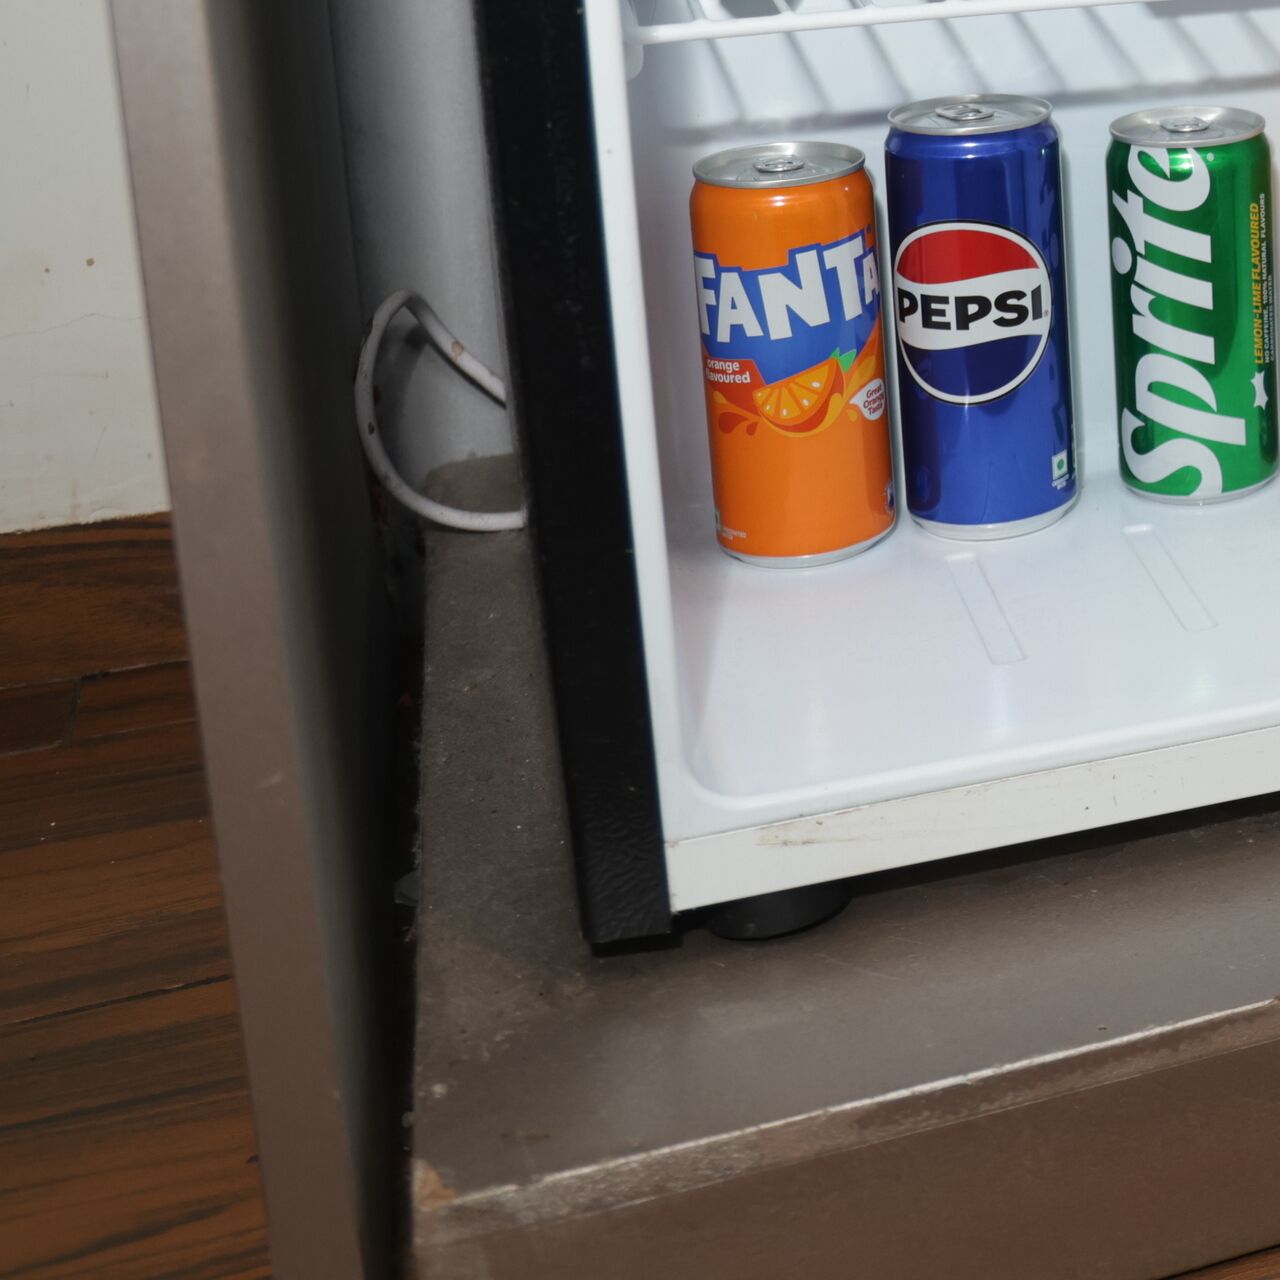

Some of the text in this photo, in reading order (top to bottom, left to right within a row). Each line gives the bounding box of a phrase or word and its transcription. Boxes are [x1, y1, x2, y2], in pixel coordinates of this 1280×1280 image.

[695, 235, 880, 343] FANTA
[897, 284, 1043, 331] PEPSI
[1111, 143, 1247, 497] Sprite
[1249, 202, 1264, 364] LEMON-LIME FLAVOURED
[1264, 352, 1270, 363] NO
